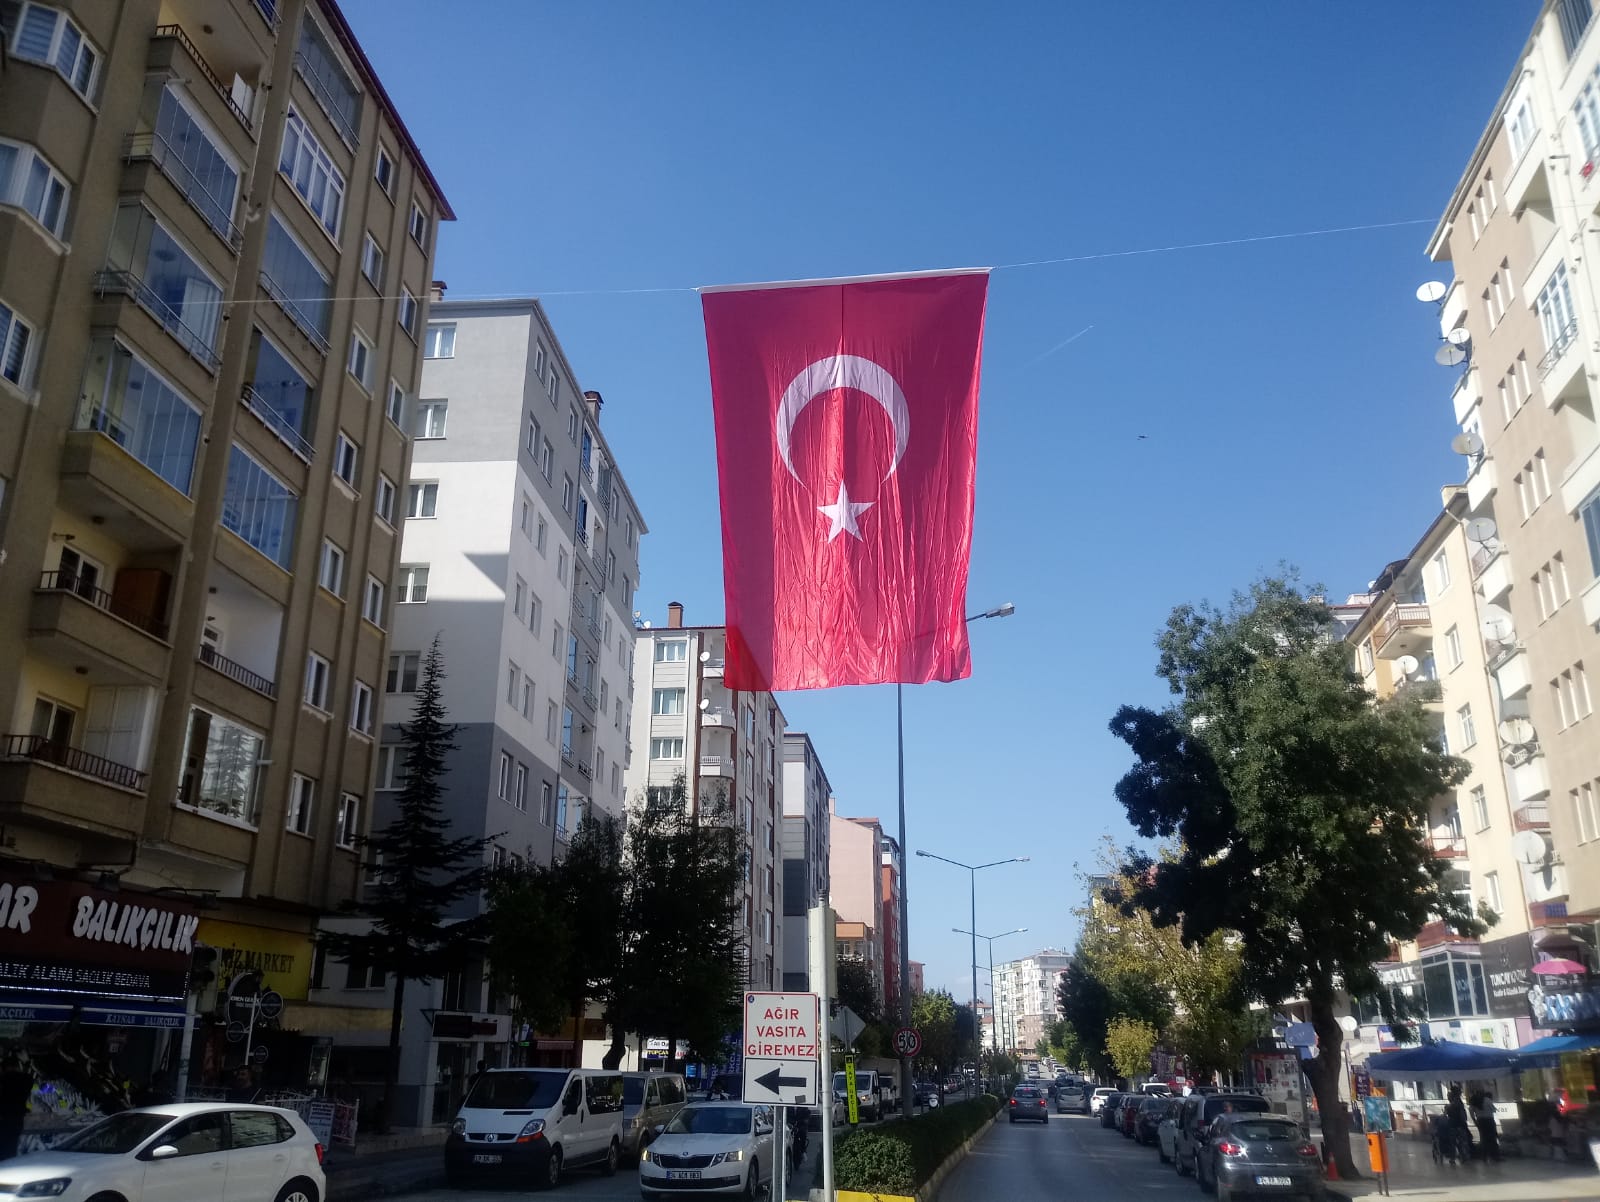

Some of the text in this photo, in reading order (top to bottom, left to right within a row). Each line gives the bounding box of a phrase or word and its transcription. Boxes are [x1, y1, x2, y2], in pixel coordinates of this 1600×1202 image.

[72, 895, 199, 954] BALIKÇILIK
[245, 950, 295, 973] MARKET
[764, 1006, 799, 1020] AĞIR
[756, 1026, 806, 1037] VASITA
[748, 1041, 815, 1056] GİREMEZ
[898, 1034, 916, 1049] 50
